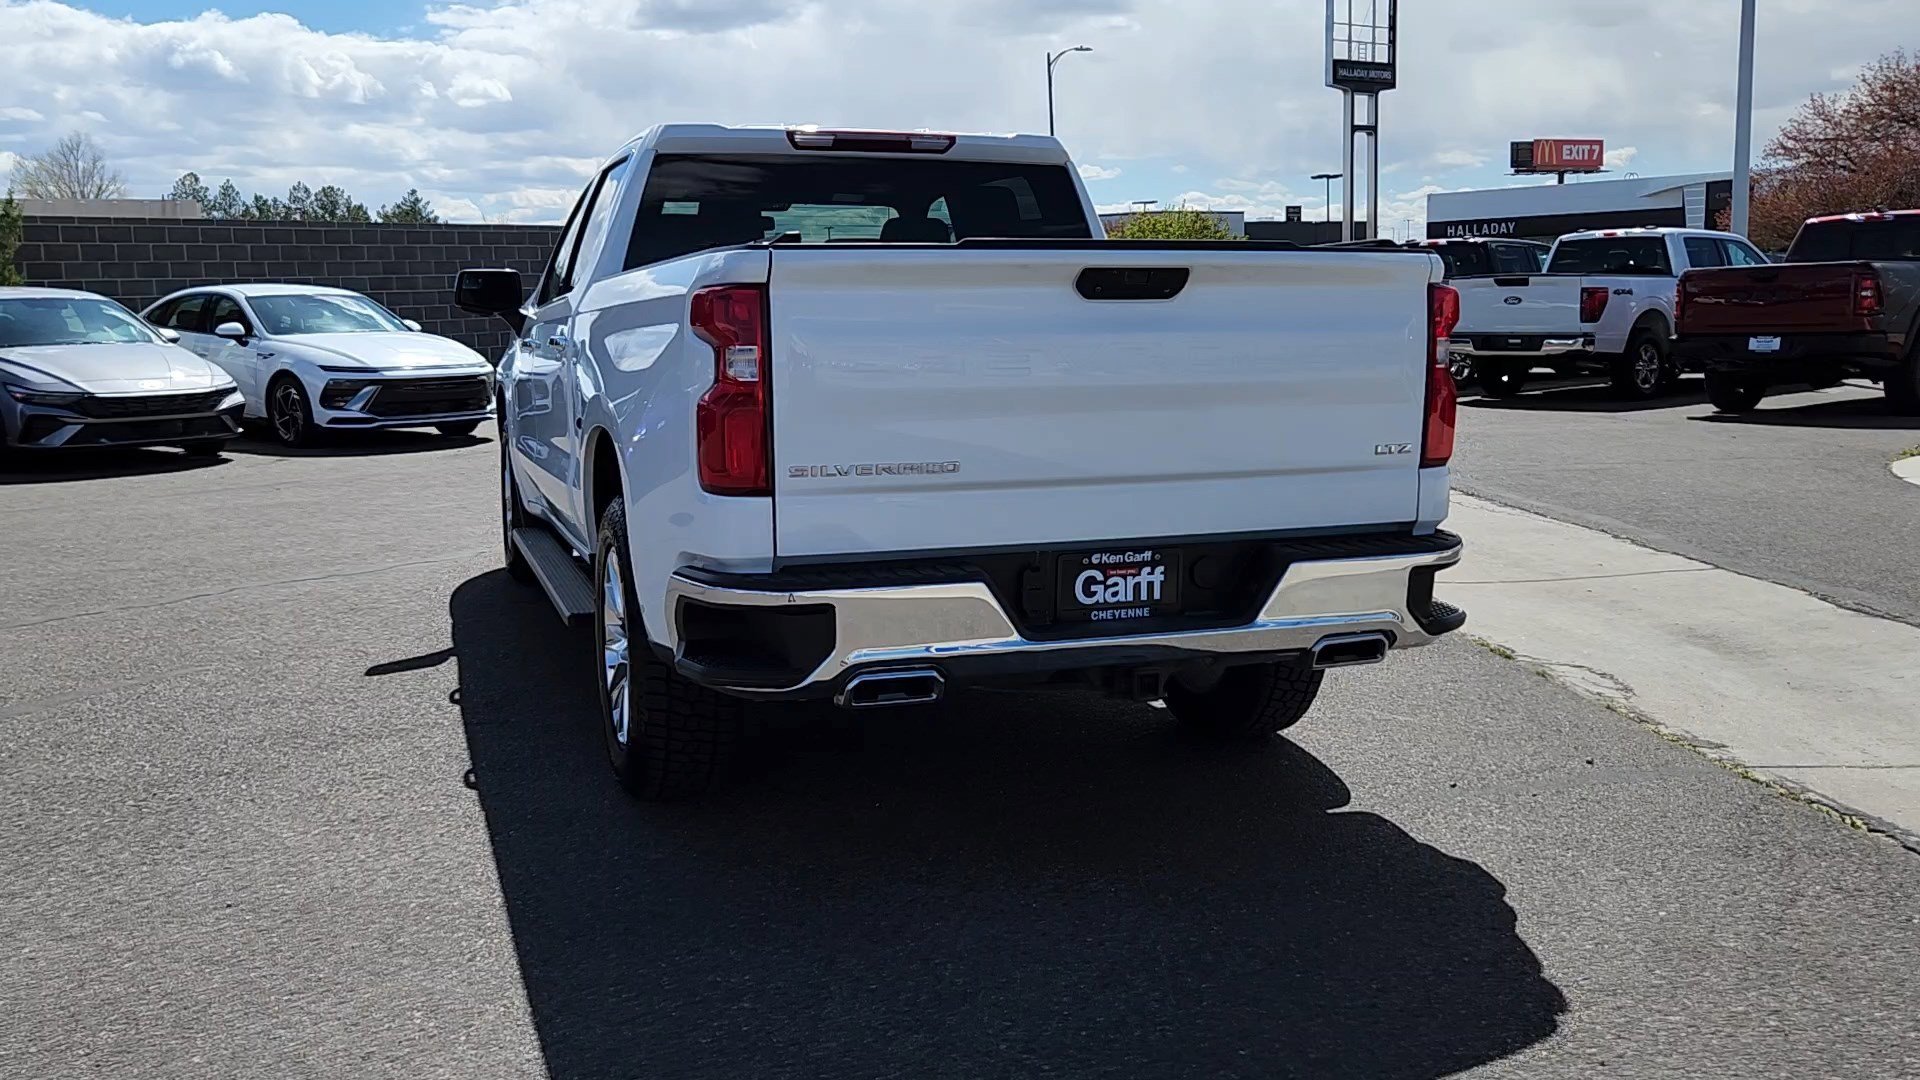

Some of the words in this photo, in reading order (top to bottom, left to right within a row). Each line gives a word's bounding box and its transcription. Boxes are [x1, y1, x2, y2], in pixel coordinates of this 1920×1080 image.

[1338, 67, 1368, 78] HALLADAY
[1368, 70, 1392, 80] MOTORS
[1562, 144, 1591, 160] EXIT
[1591, 144, 1600, 160] 7
[1447, 221, 1516, 237] HALLADAY
[1375, 442, 1412, 455] LTZ
[788, 460, 961, 478] SILVERADO
[1101, 552, 1123, 564] Ken
[1124, 550, 1152, 563] Garff
[1074, 566, 1165, 605] Garff
[1091, 607, 1150, 620] CHEYENNE
